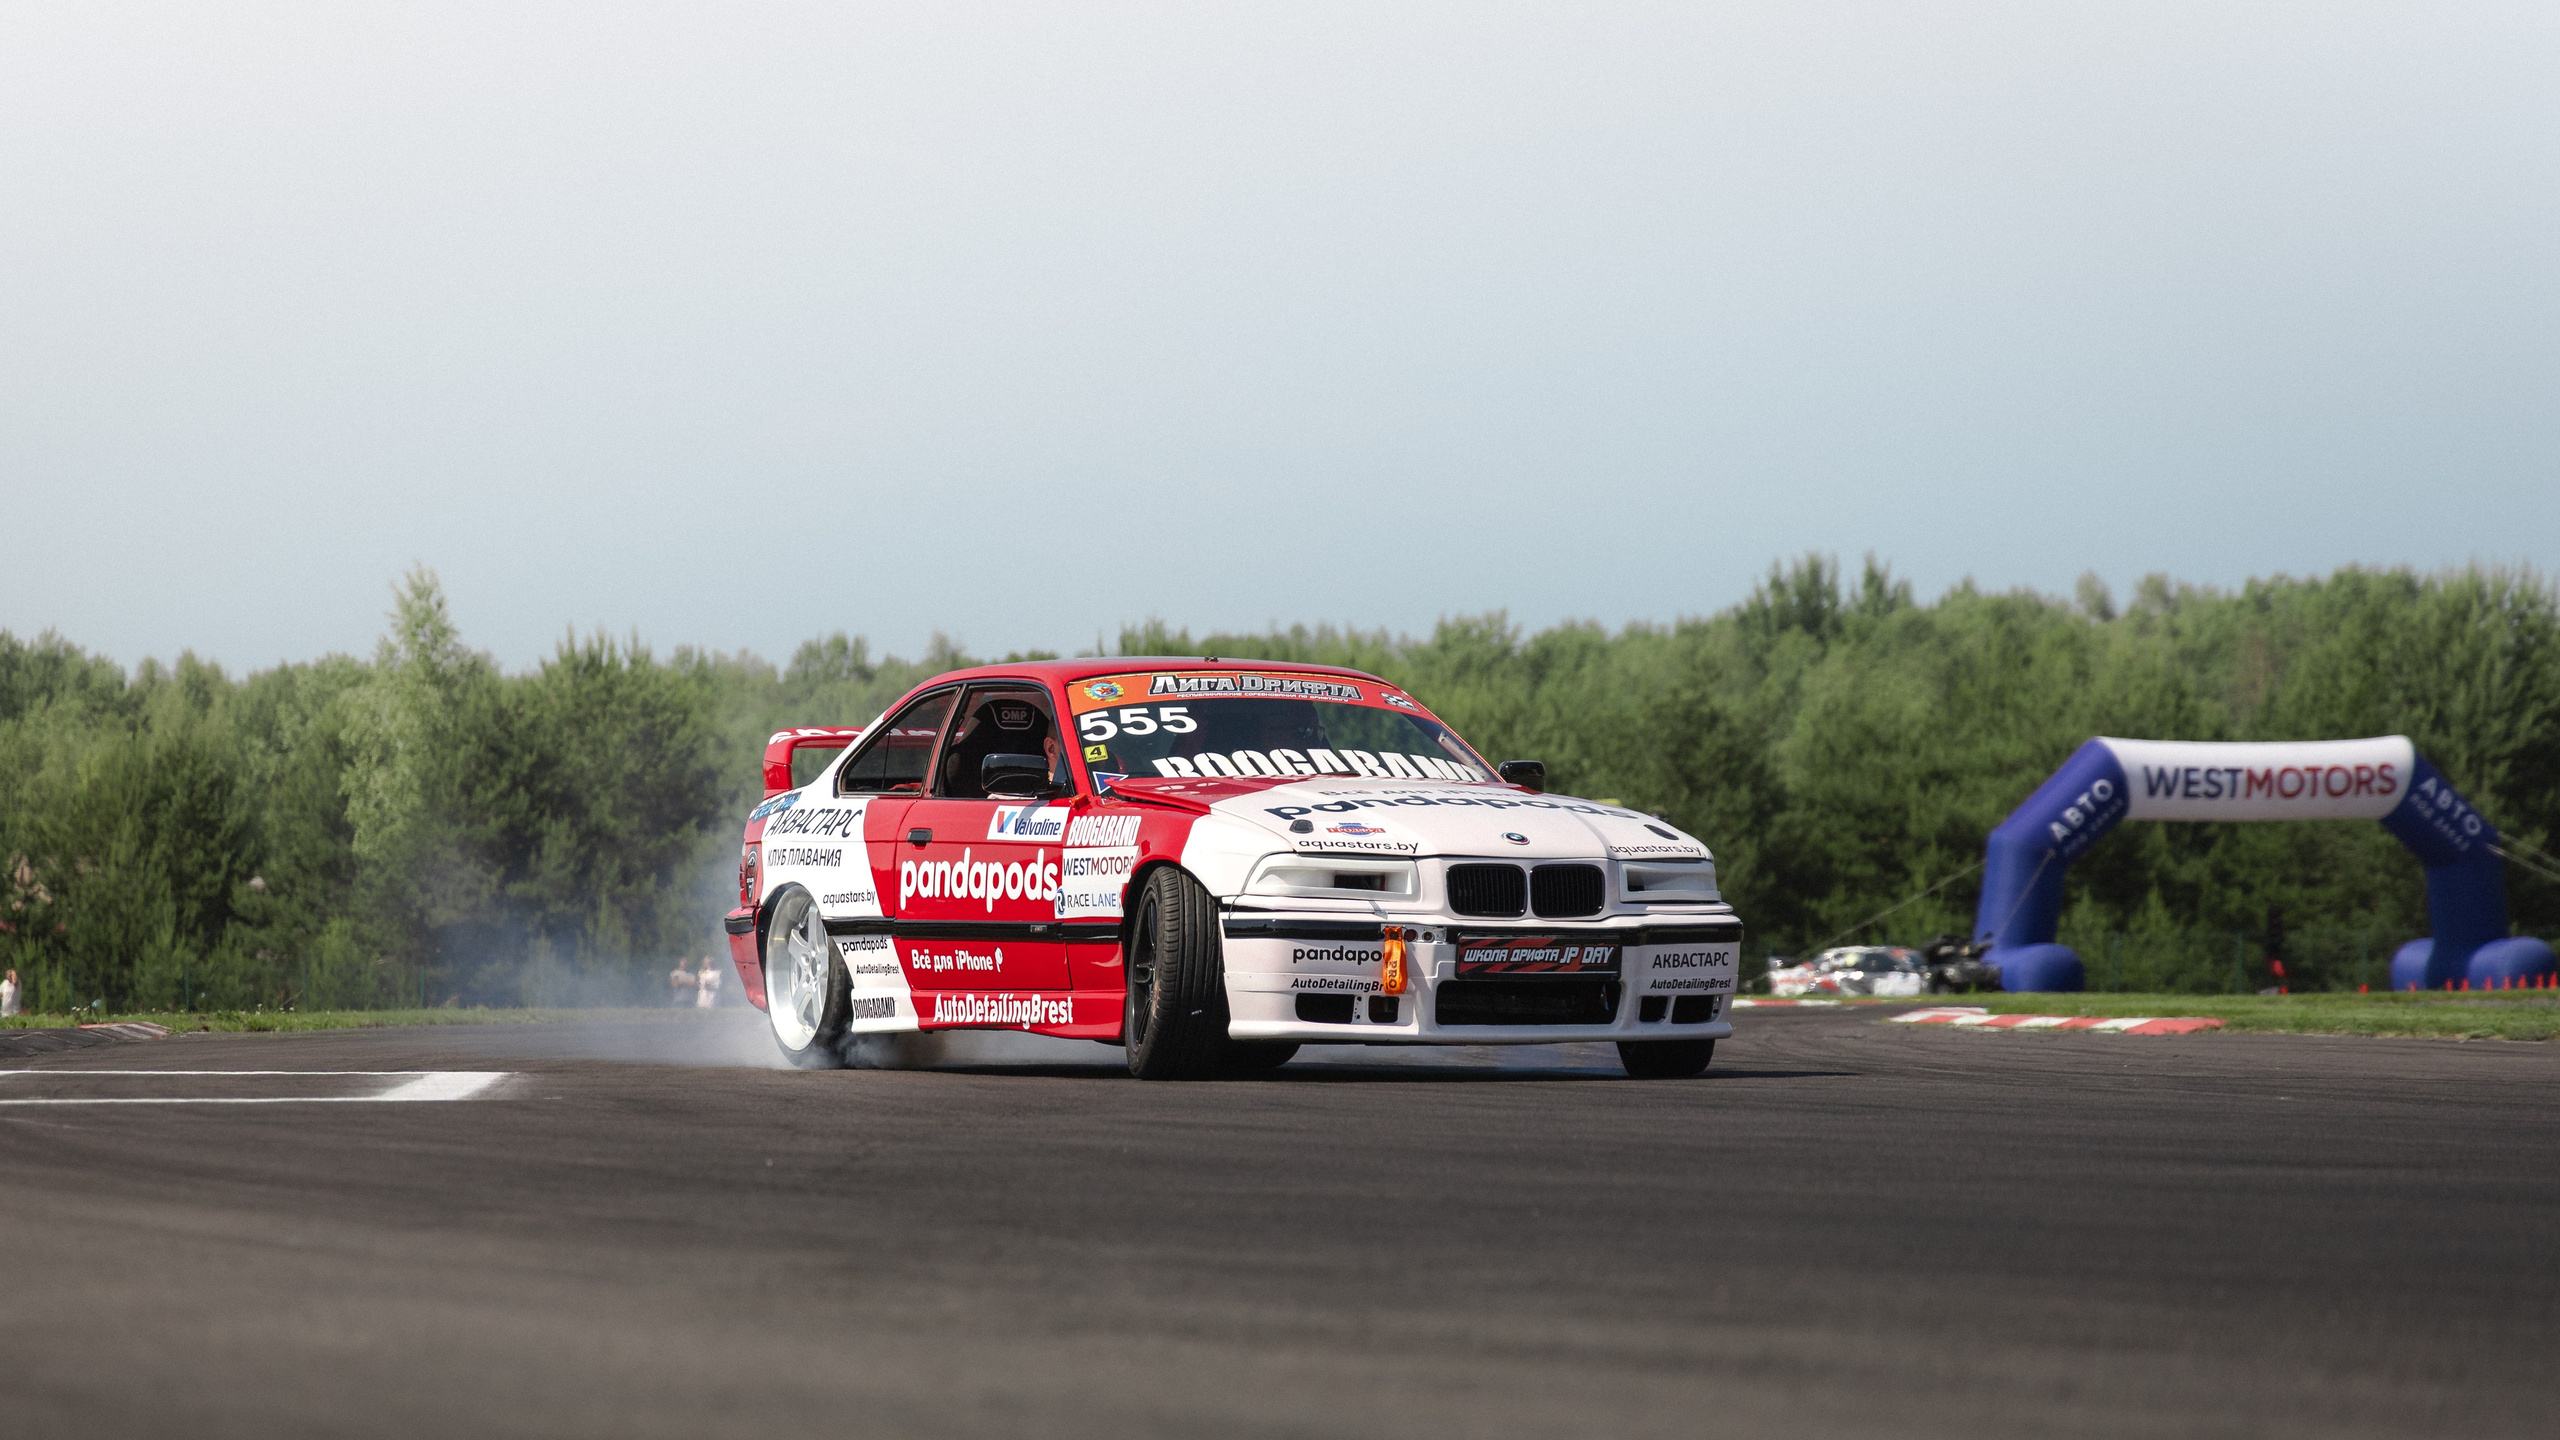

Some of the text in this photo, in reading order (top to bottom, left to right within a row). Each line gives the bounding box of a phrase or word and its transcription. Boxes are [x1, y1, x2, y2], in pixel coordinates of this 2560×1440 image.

[1001, 710, 1027, 720] OMP
[1080, 706, 1198, 742] 555
[1090, 746, 1102, 756] 4
[2143, 763, 2398, 799] WESTMOTORS
[1264, 795, 1639, 820] pandapods
[2050, 779, 2114, 842] АВТО
[2420, 777, 2482, 836] АВТО
[765, 808, 863, 838] АКВАСТАРС
[1014, 818, 1061, 835] Valvoline
[1066, 815, 1142, 847] BOOGABAND
[1299, 838, 1419, 854] aquastars.by
[1609, 843, 1701, 857] aquastars.by
[767, 848, 842, 867] КЛУБ ПЛАВАНИЯ
[1063, 856, 1134, 876] WESTMOTORS
[900, 847, 1058, 913] pandapods
[822, 889, 876, 908] aquastars.by
[1067, 894, 1089, 908] RACE
[1091, 893, 1116, 907] LANE
[842, 937, 888, 955] pandapods
[1293, 945, 1385, 966] pandapo
[1464, 947, 1615, 964] ШКОЛА ДРИФТА JP DAY
[856, 963, 900, 976] AutoDetailingBrest
[911, 949, 993, 973] Всё для iPhone
[1652, 952, 1729, 969] АКВАСТАРС
[1291, 978, 1384, 993] AutoDetailingBr
[1650, 978, 1731, 991] AutoDetailingBrest
[853, 996, 897, 1020] BOOGABAND
[933, 993, 1073, 1030] AutoDetailingBrest
